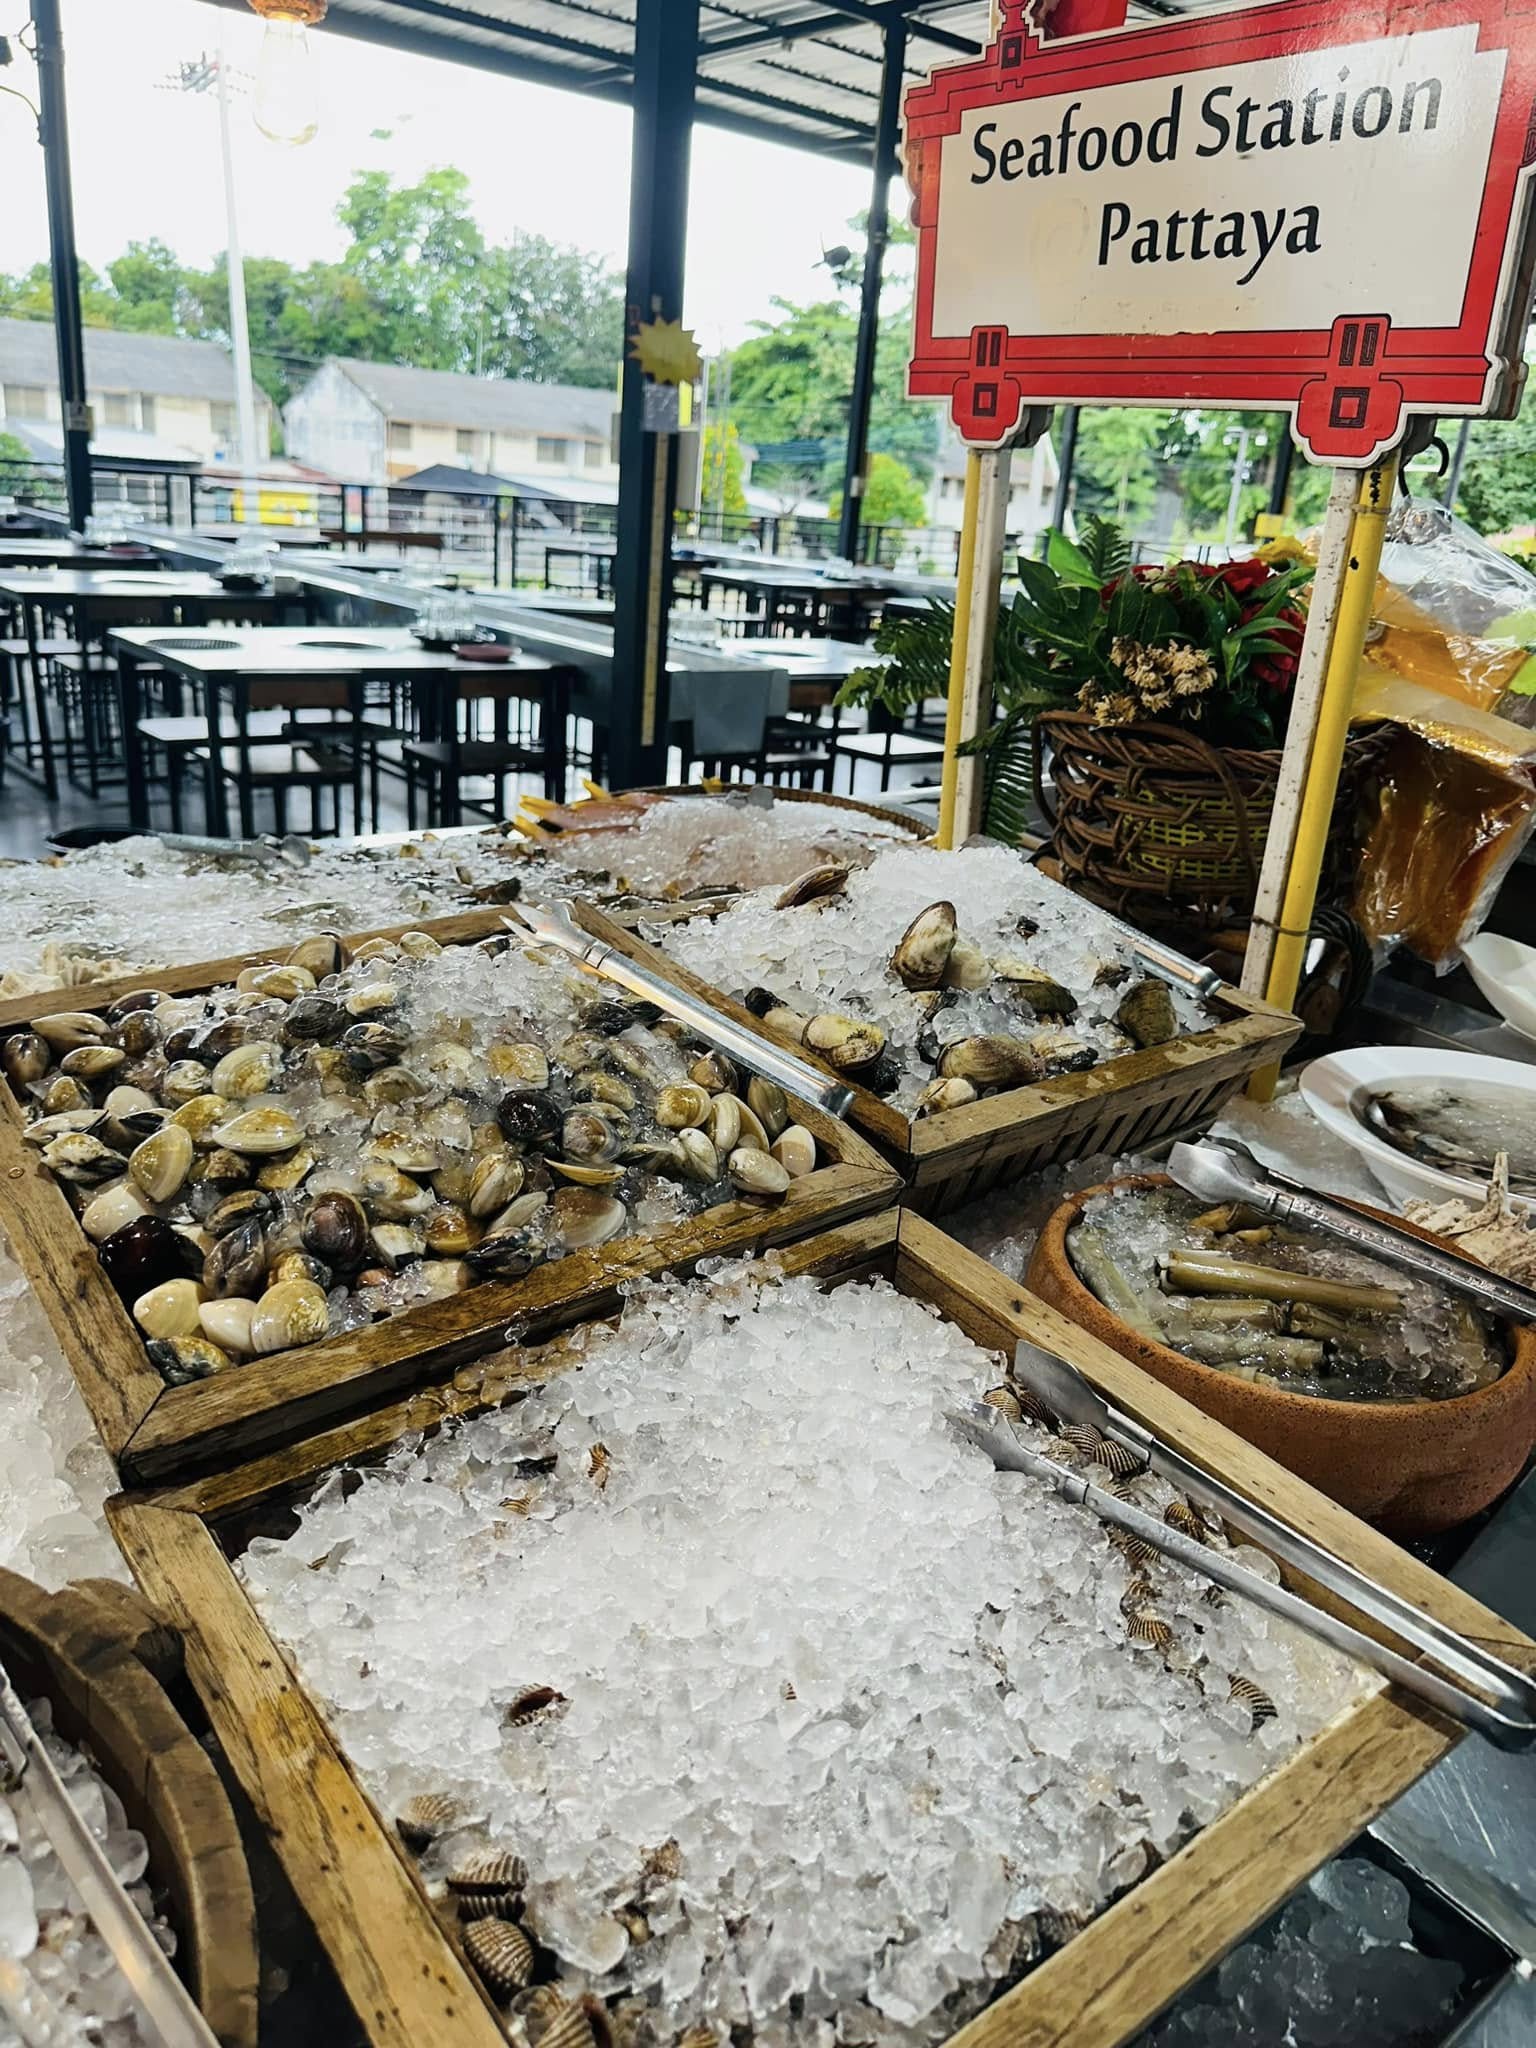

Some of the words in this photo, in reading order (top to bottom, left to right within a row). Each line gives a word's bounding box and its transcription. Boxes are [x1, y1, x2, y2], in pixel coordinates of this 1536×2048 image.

[970, 85, 1184, 185] Seafood
[1195, 64, 1443, 158] Station
[1097, 201, 1322, 286] Pattaya
